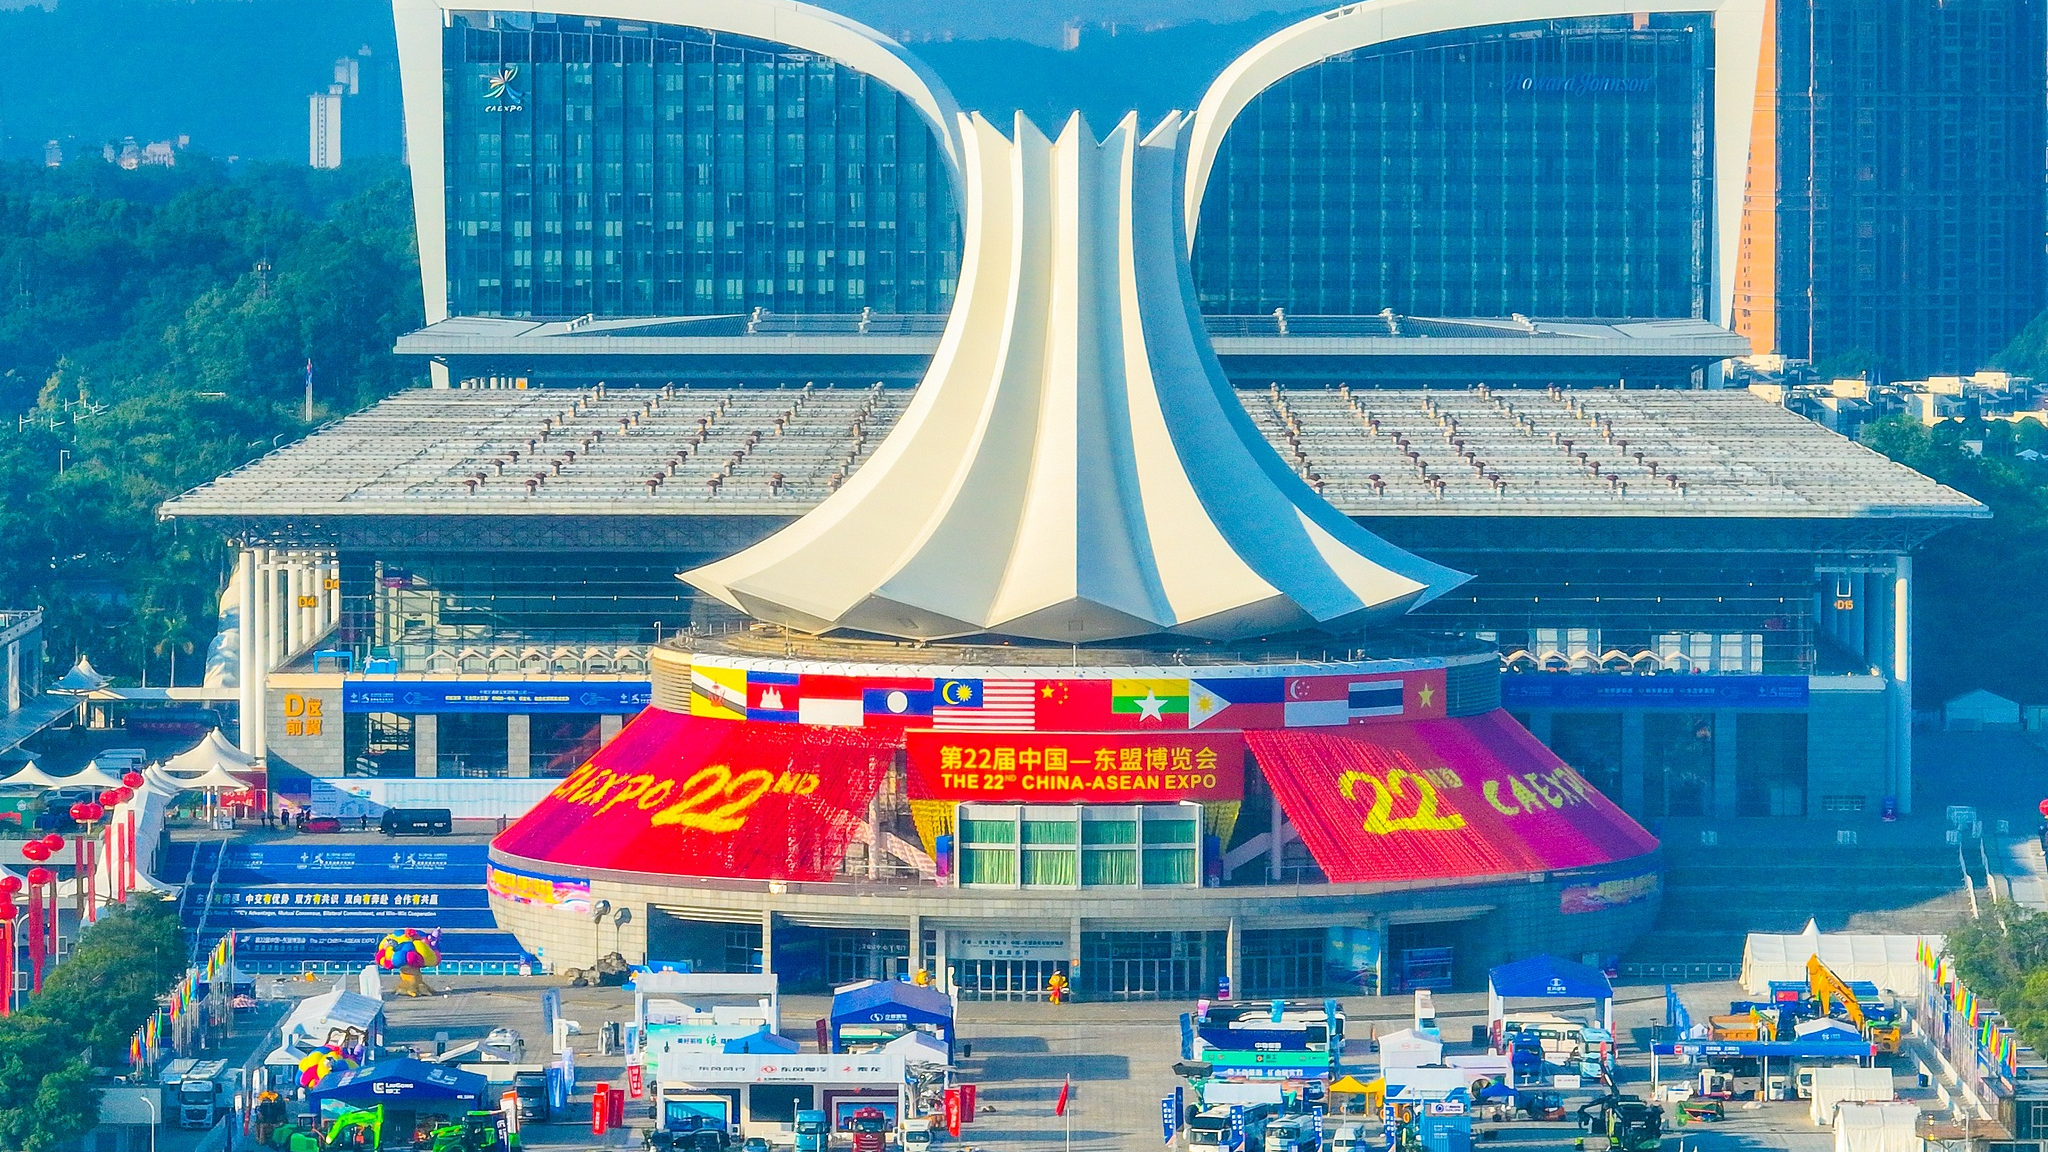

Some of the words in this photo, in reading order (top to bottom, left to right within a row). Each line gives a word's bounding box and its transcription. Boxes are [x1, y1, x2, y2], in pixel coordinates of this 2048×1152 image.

[1505, 72, 1576, 92] Howard
[1575, 71, 1651, 97] Johnson
[941, 774, 979, 789] THE
[1021, 774, 1160, 790] CHINA-ASEAN
[1164, 774, 1217, 789] EXPO
